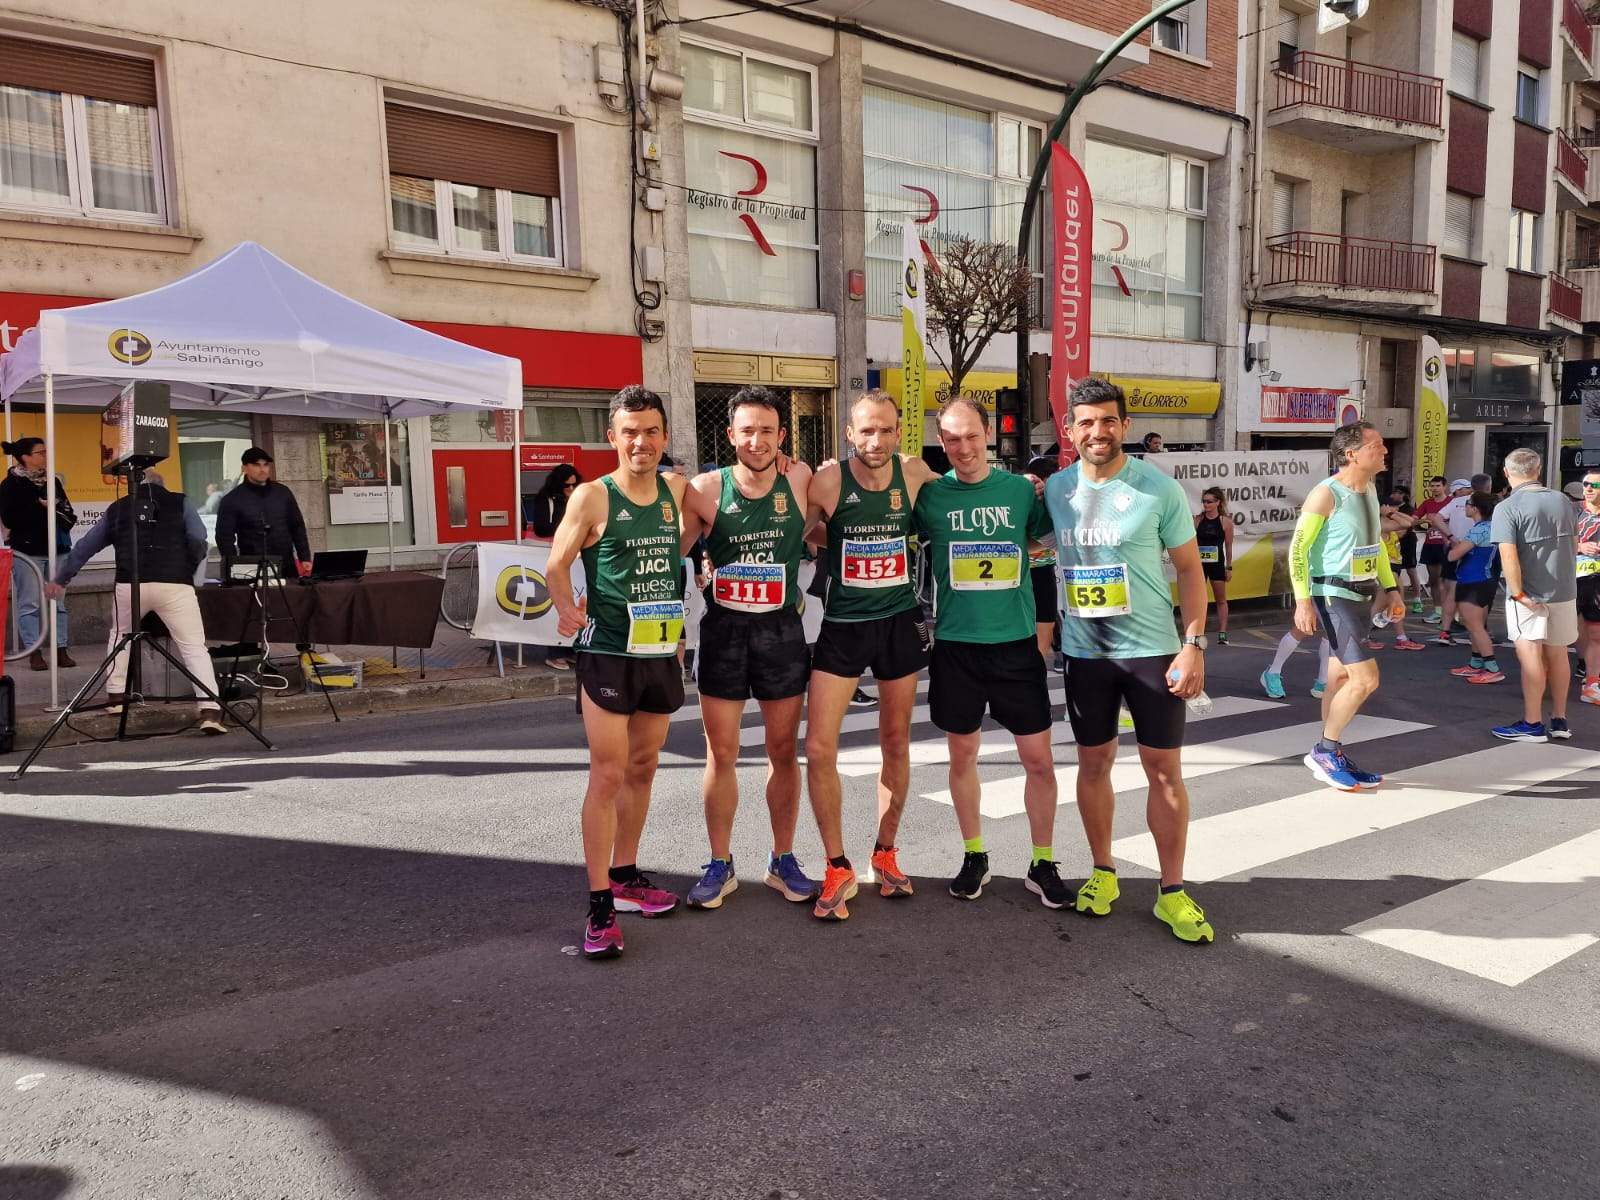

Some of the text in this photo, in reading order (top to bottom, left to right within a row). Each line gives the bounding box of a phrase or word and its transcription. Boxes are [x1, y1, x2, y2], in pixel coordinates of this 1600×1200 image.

[688, 189, 806, 220] Registro de la Propiedad
[876, 218, 904, 236] Registr
[158, 340, 261, 357] Ayuntamiento
[177, 352, 264, 368] Sabiñánigo
[852, 378, 863, 388] 92
[1143, 391, 1189, 408] CORREOS
[1475, 404, 1510, 417] ARLET
[135, 415, 169, 429] ZARAGOZA
[1174, 458, 1310, 480] MEDIO MARATÓN
[844, 523, 900, 534] FLORISTERÍA
[946, 506, 1016, 536] EL CISNE
[729, 528, 784, 543] FLORISTERÍA
[1079, 527, 1121, 547] CISNE
[637, 547, 670, 558] EL CISNE
[752, 541, 775, 551] CISNE
[846, 543, 870, 552] MEDIA
[953, 544, 977, 553] MEDIA
[635, 558, 671, 575] JACA
[718, 566, 743, 576] MEDIA
[856, 557, 897, 578] 152
[978, 560, 993, 579] 2
[729, 582, 769, 602] 111
[1077, 586, 1107, 606] 53
[659, 621, 667, 641] 1
